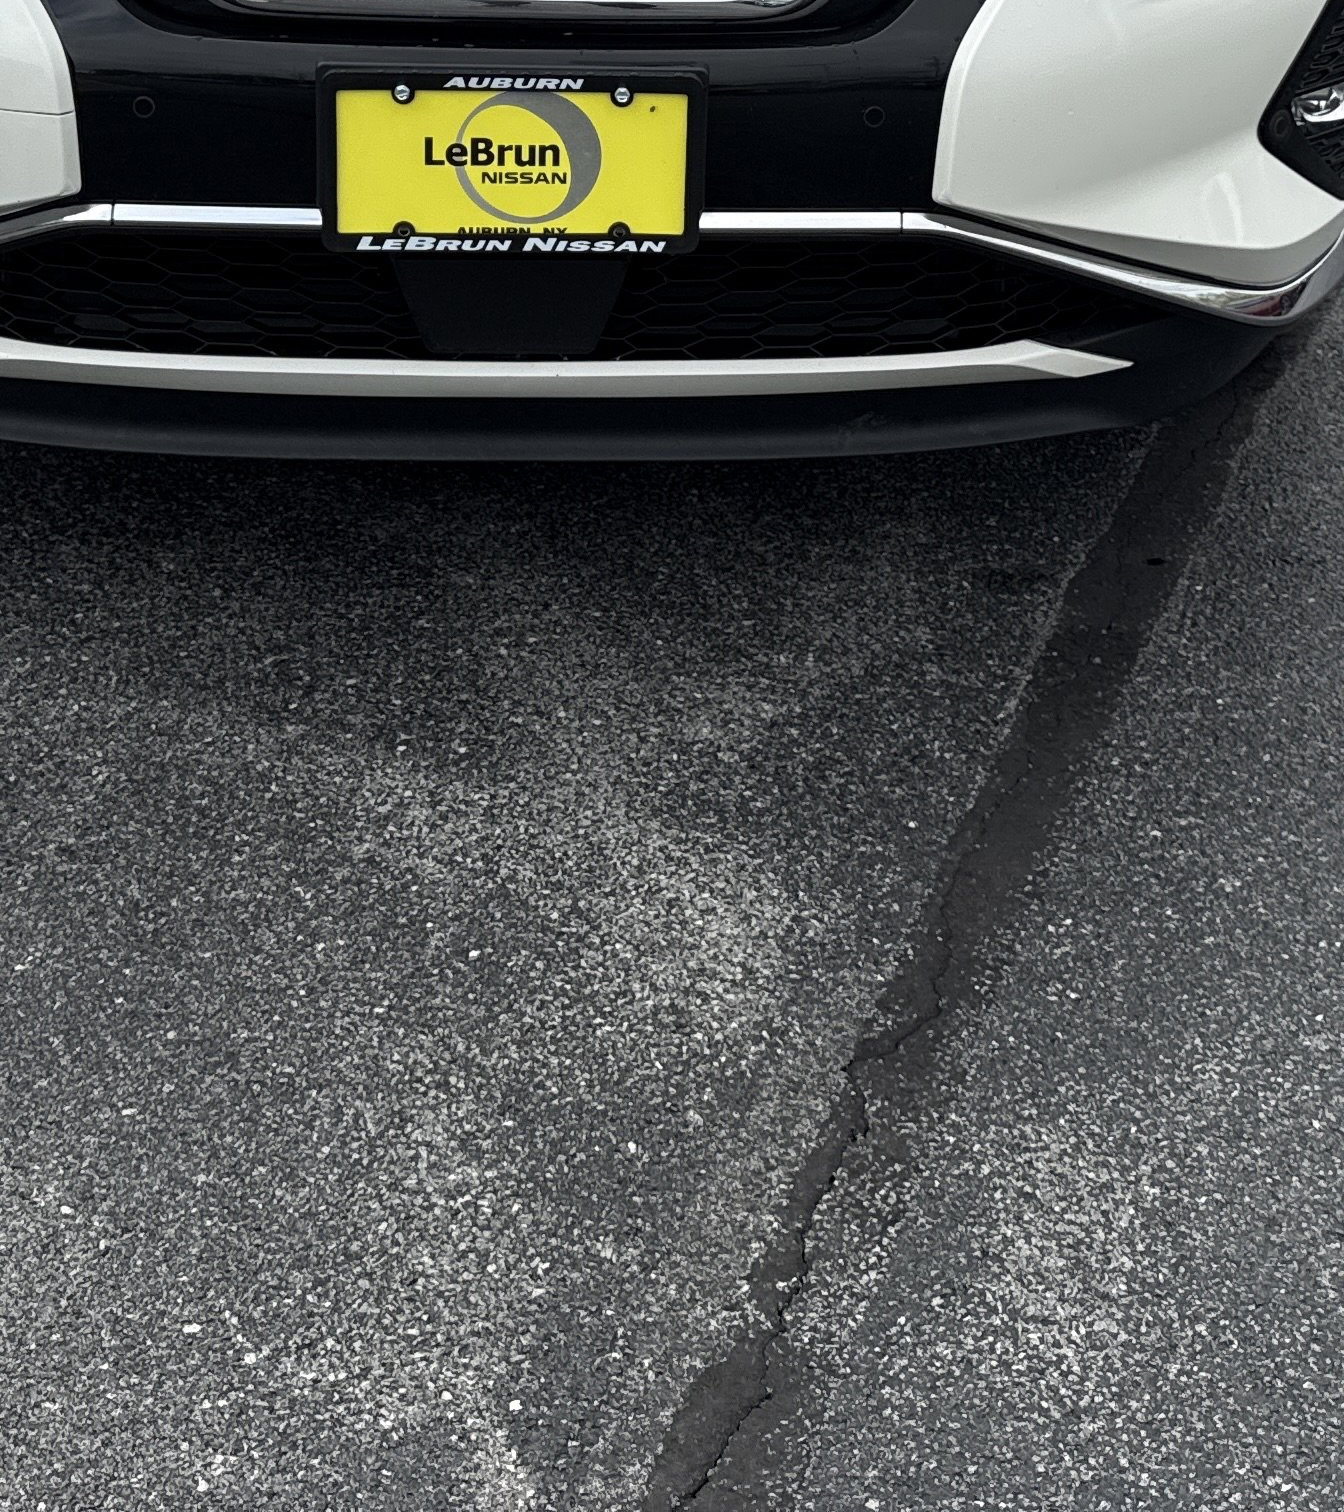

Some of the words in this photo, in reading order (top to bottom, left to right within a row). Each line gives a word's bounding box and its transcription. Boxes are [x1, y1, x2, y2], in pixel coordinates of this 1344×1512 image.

[443, 76, 585, 90] AUBURN
[424, 136, 561, 167] LeBrun
[481, 171, 568, 185] NISSAN
[521, 236, 667, 253] NISSAN
